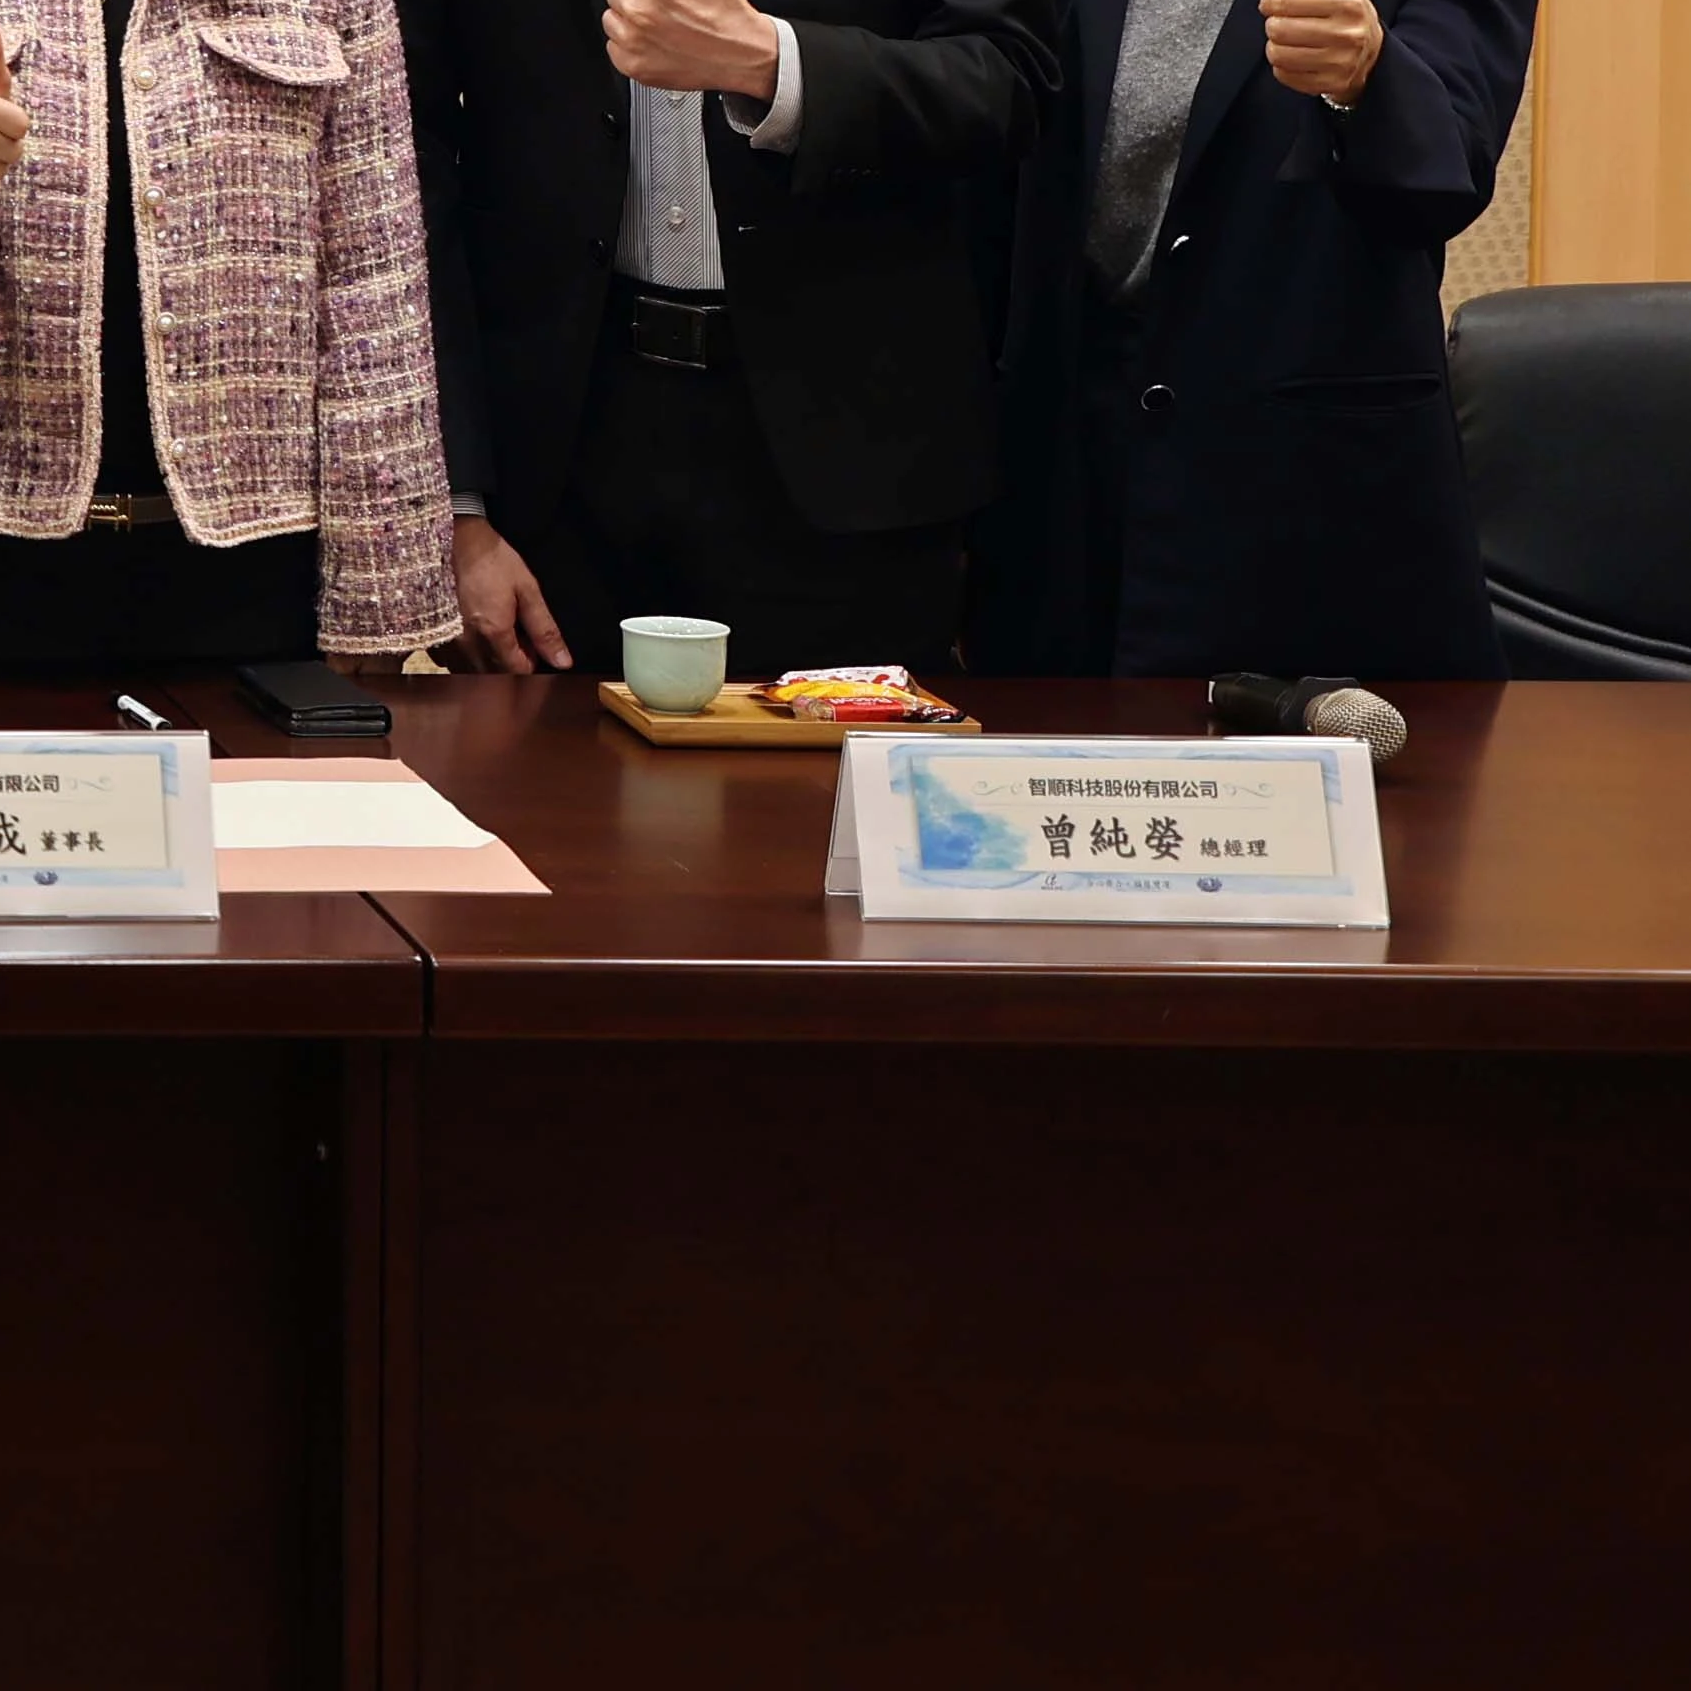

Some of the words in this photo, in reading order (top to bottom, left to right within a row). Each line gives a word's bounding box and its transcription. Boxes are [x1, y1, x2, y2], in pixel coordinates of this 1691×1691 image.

[1027, 776, 1219, 800] 智順科技股份有限公司
[40, 829, 105, 853] 董事長
[1199, 836, 1269, 859] 總經理
